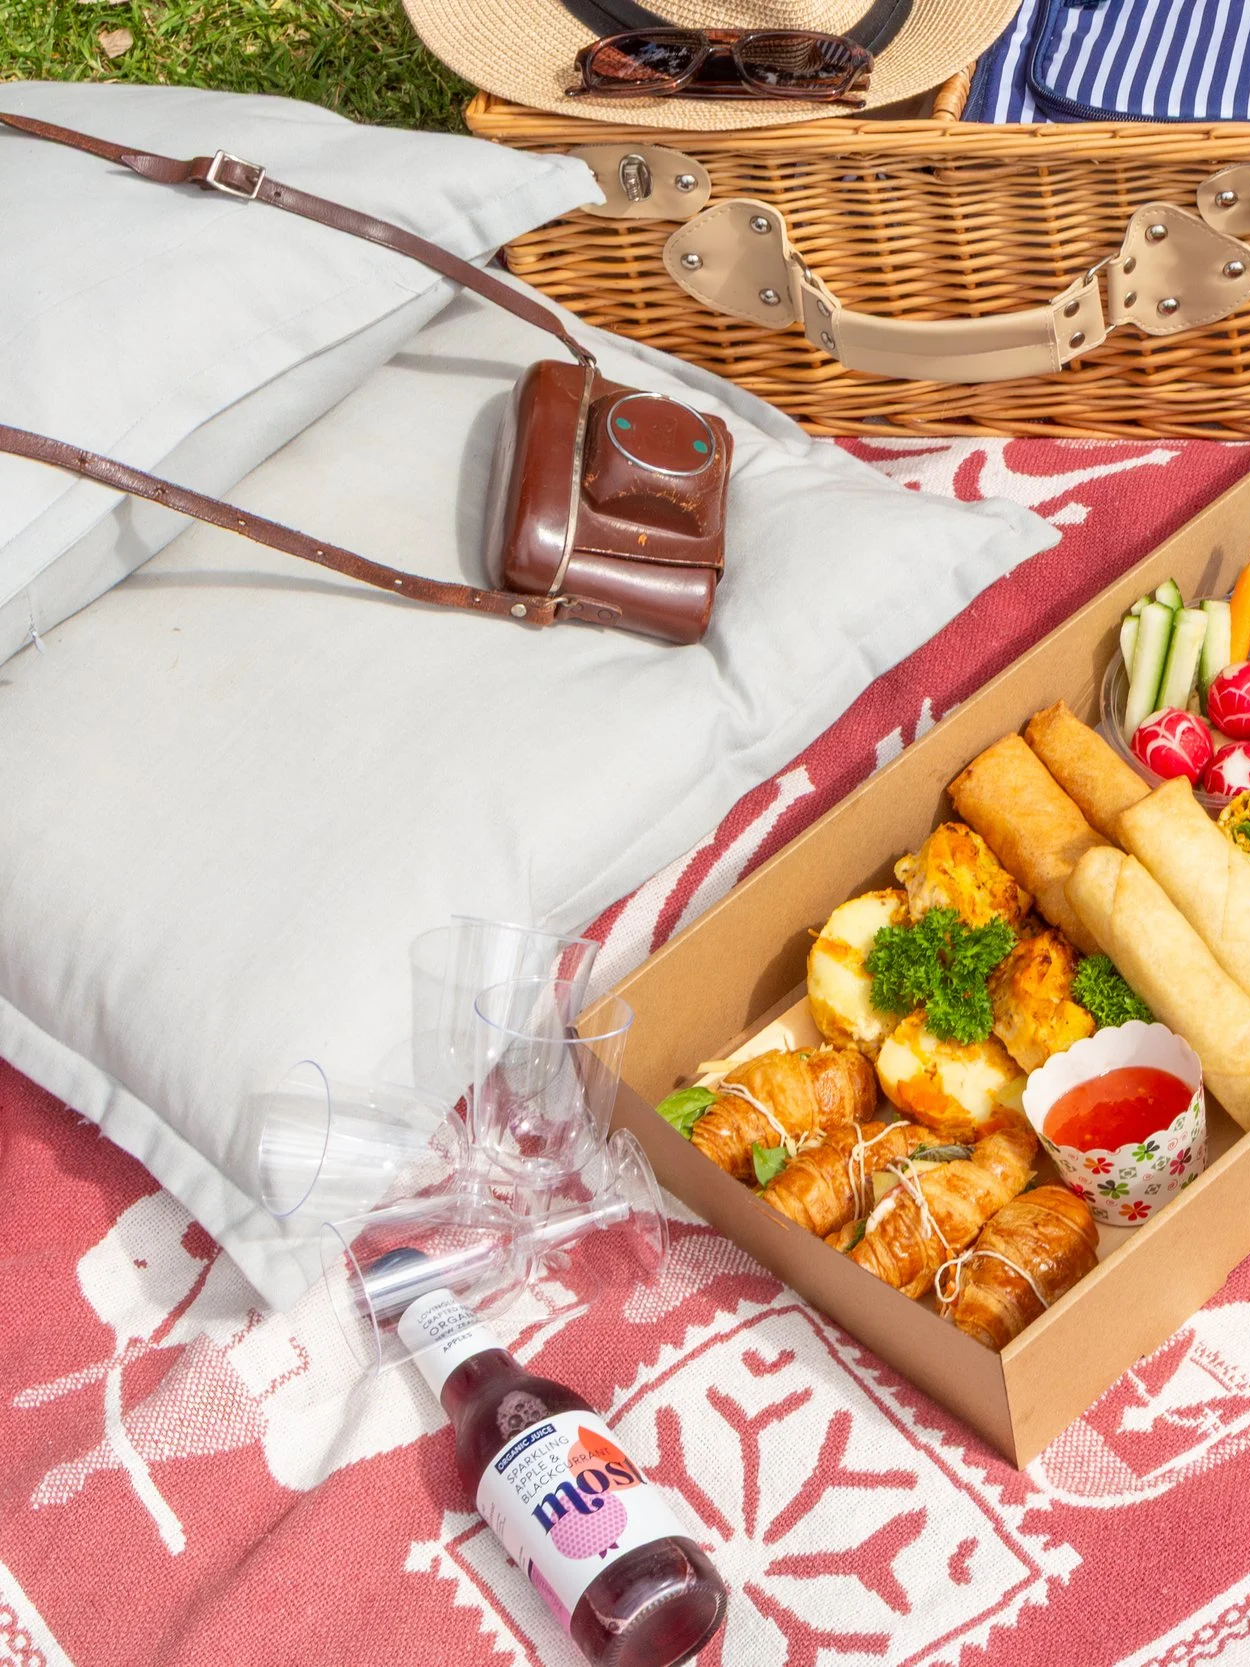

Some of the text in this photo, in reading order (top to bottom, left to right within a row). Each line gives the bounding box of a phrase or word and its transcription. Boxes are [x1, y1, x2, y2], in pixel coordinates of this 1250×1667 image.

[443, 1332, 472, 1353] APPLES
[497, 1424, 554, 1470] ORGANIC JUICE
[506, 1435, 570, 1484] SPARKLING
[514, 1454, 560, 1495] APPLE &
[521, 1447, 610, 1504] BLACKCURRANT
